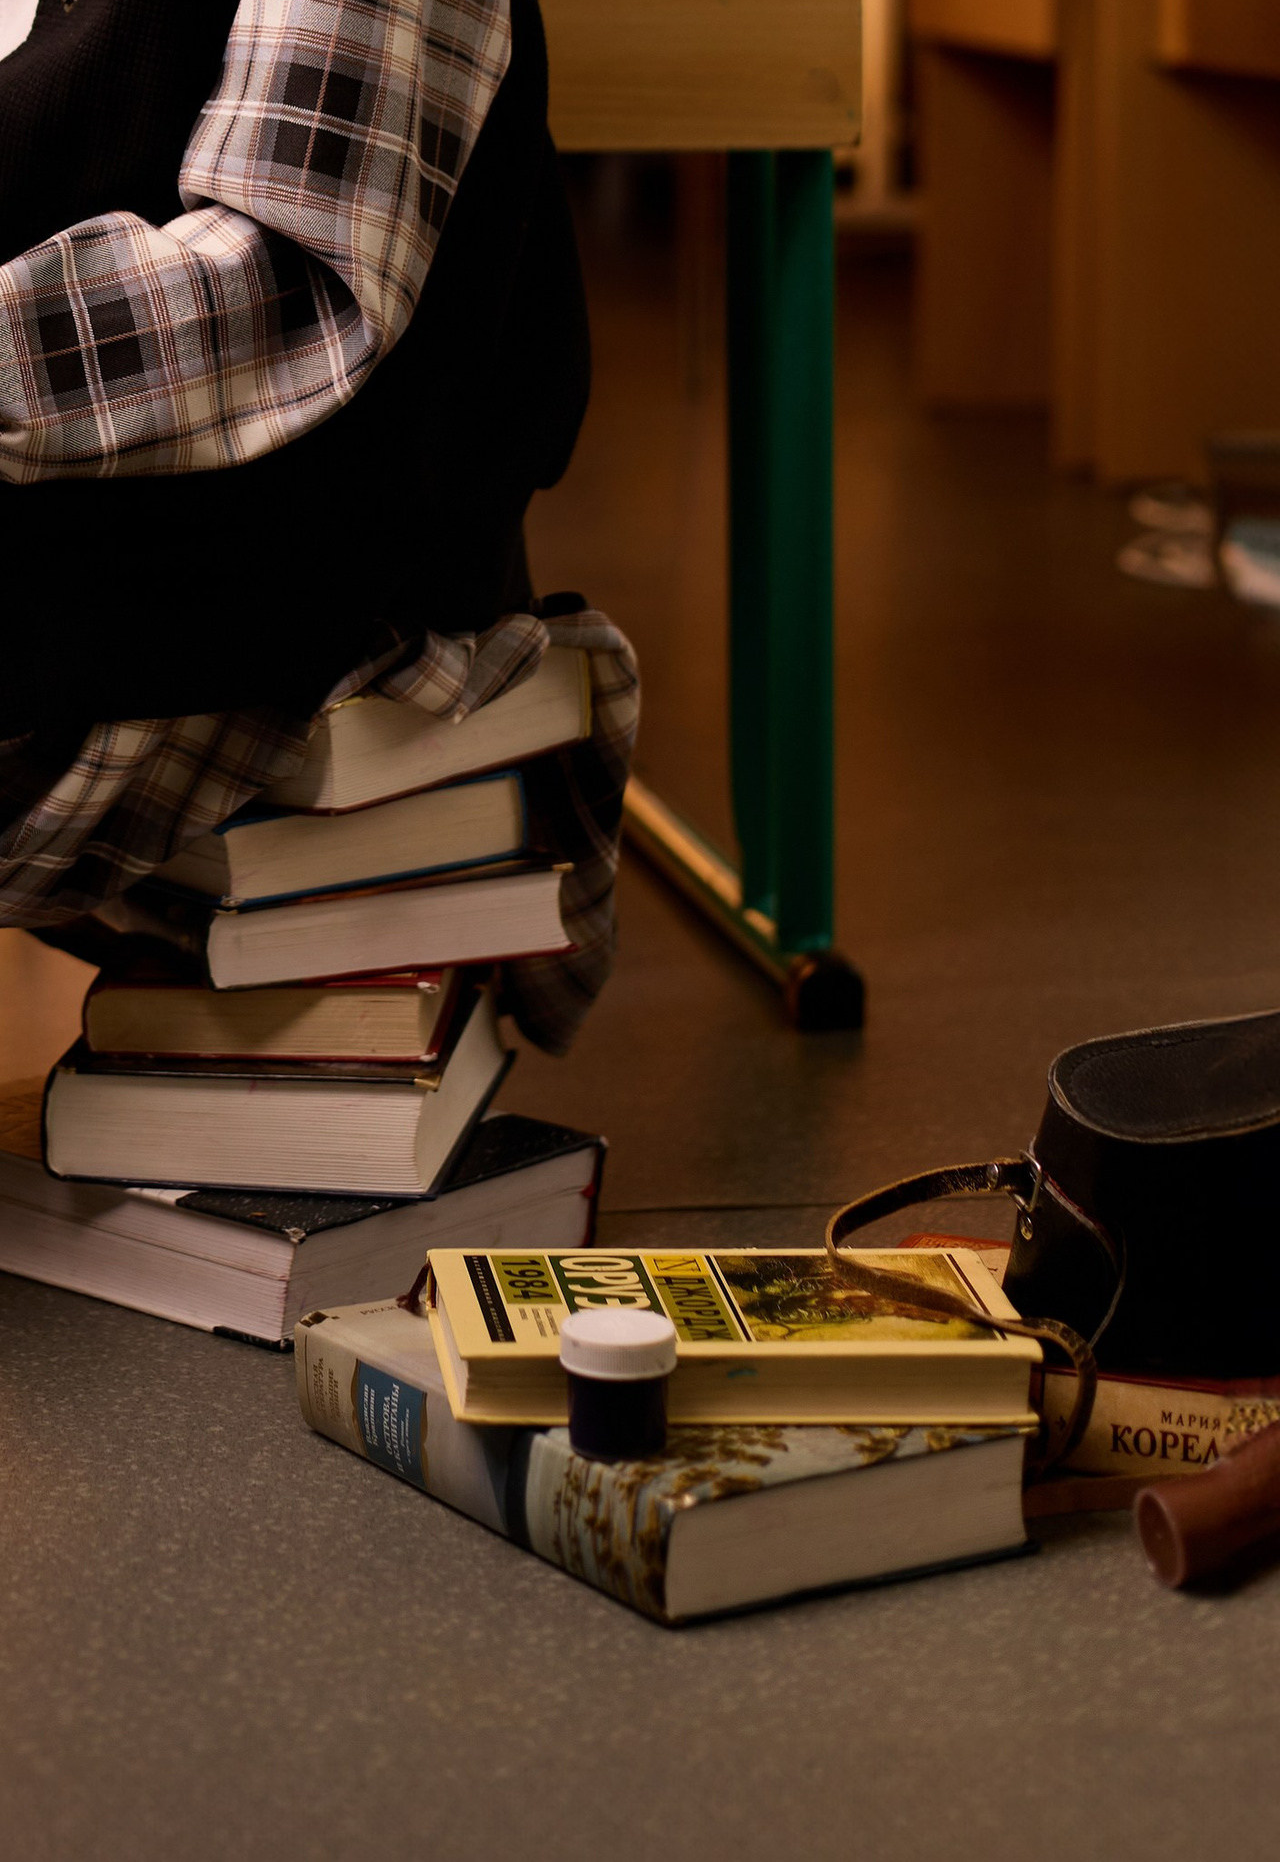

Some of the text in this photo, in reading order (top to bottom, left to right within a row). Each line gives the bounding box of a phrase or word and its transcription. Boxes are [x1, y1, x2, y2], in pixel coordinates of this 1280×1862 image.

[501, 1258, 554, 1300] 1984
[559, 1256, 652, 1311] ОРУЭ
[655, 1276, 734, 1340] ДЖОРДЖ
[364, 1384, 372, 1444] Владислав
[370, 1388, 378, 1446] Крапивин
[382, 1396, 392, 1455] ОСТРОВА
[390, 1383, 404, 1473] И КАПИТАНЫ
[1161, 1410, 1220, 1430] МАРИЯ
[1110, 1423, 1220, 1465] КОРЕЛ
